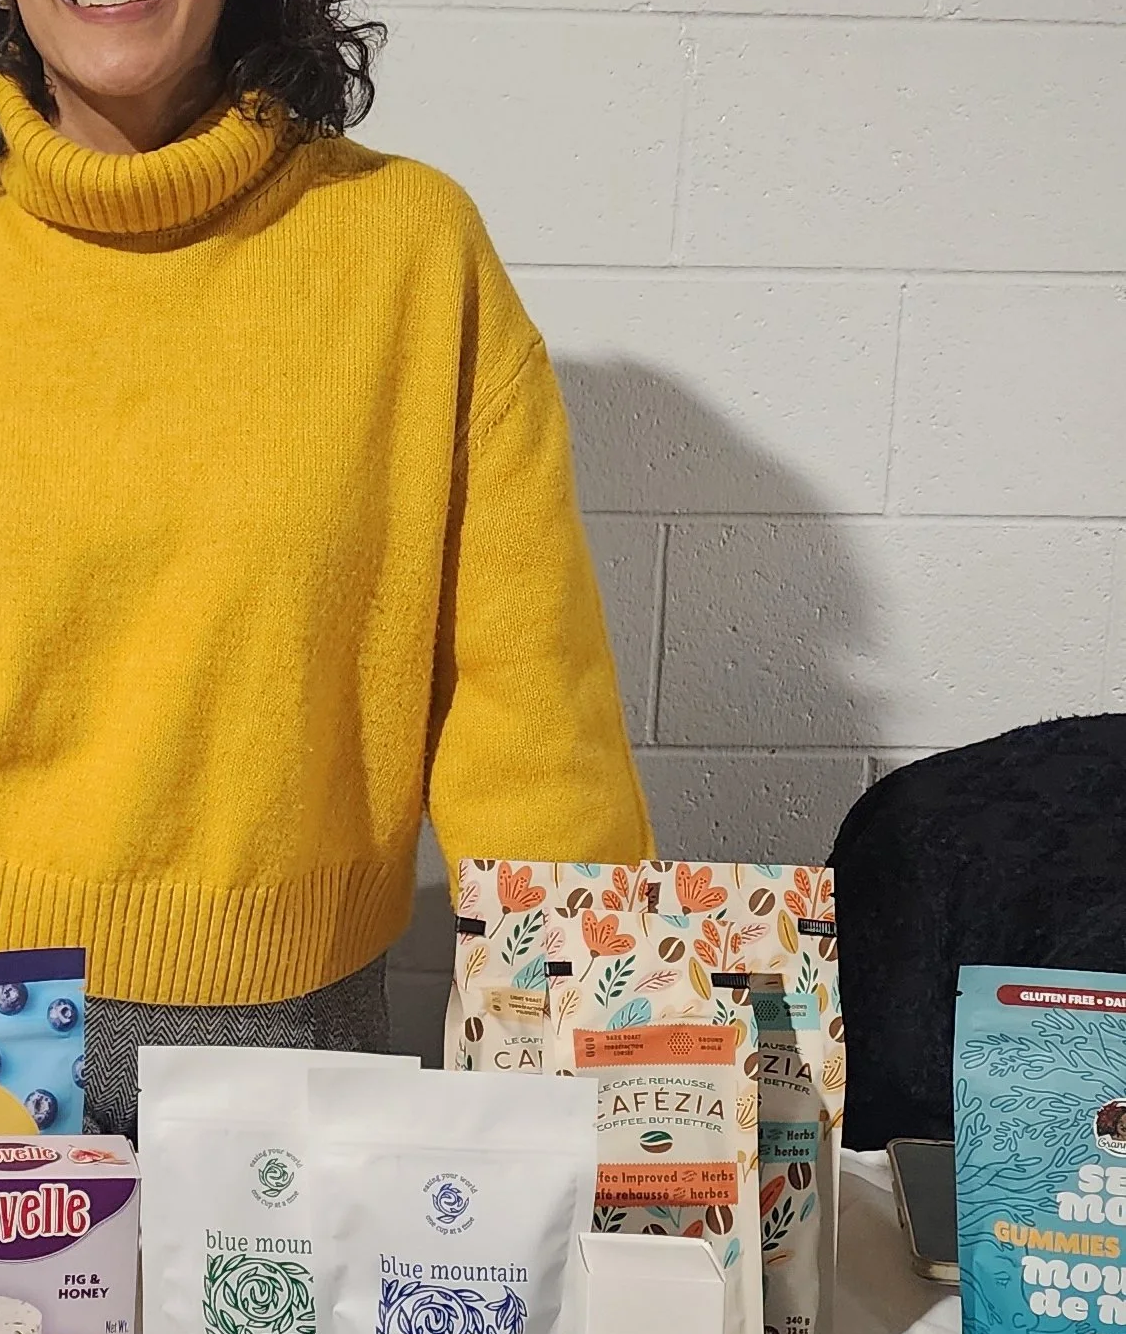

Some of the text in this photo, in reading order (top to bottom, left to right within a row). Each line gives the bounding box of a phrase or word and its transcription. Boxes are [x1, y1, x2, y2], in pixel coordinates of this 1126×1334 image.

[1020, 991, 1095, 1006] GLUTEN FREE
[648, 1116, 673, 1124] BUT
[786, 1130, 815, 1141] Herbs
[774, 1146, 810, 1157] herbes
[621, 1170, 735, 1186] Improved Herbs
[616, 1187, 730, 1200] rehaussé herbes
[435, 1223, 449, 1236] cup
[205, 1229, 248, 1253] blue
[994, 1220, 1121, 1259] GUMMIES
[379, 1253, 529, 1283] blue mountain
[64, 1274, 101, 1286] FIG &
[57, 1287, 110, 1299] HONEY
[1029, 1288, 1088, 1321] de
[785, 1316, 803, 1325] 340
[787, 1327, 797, 1334] 12
